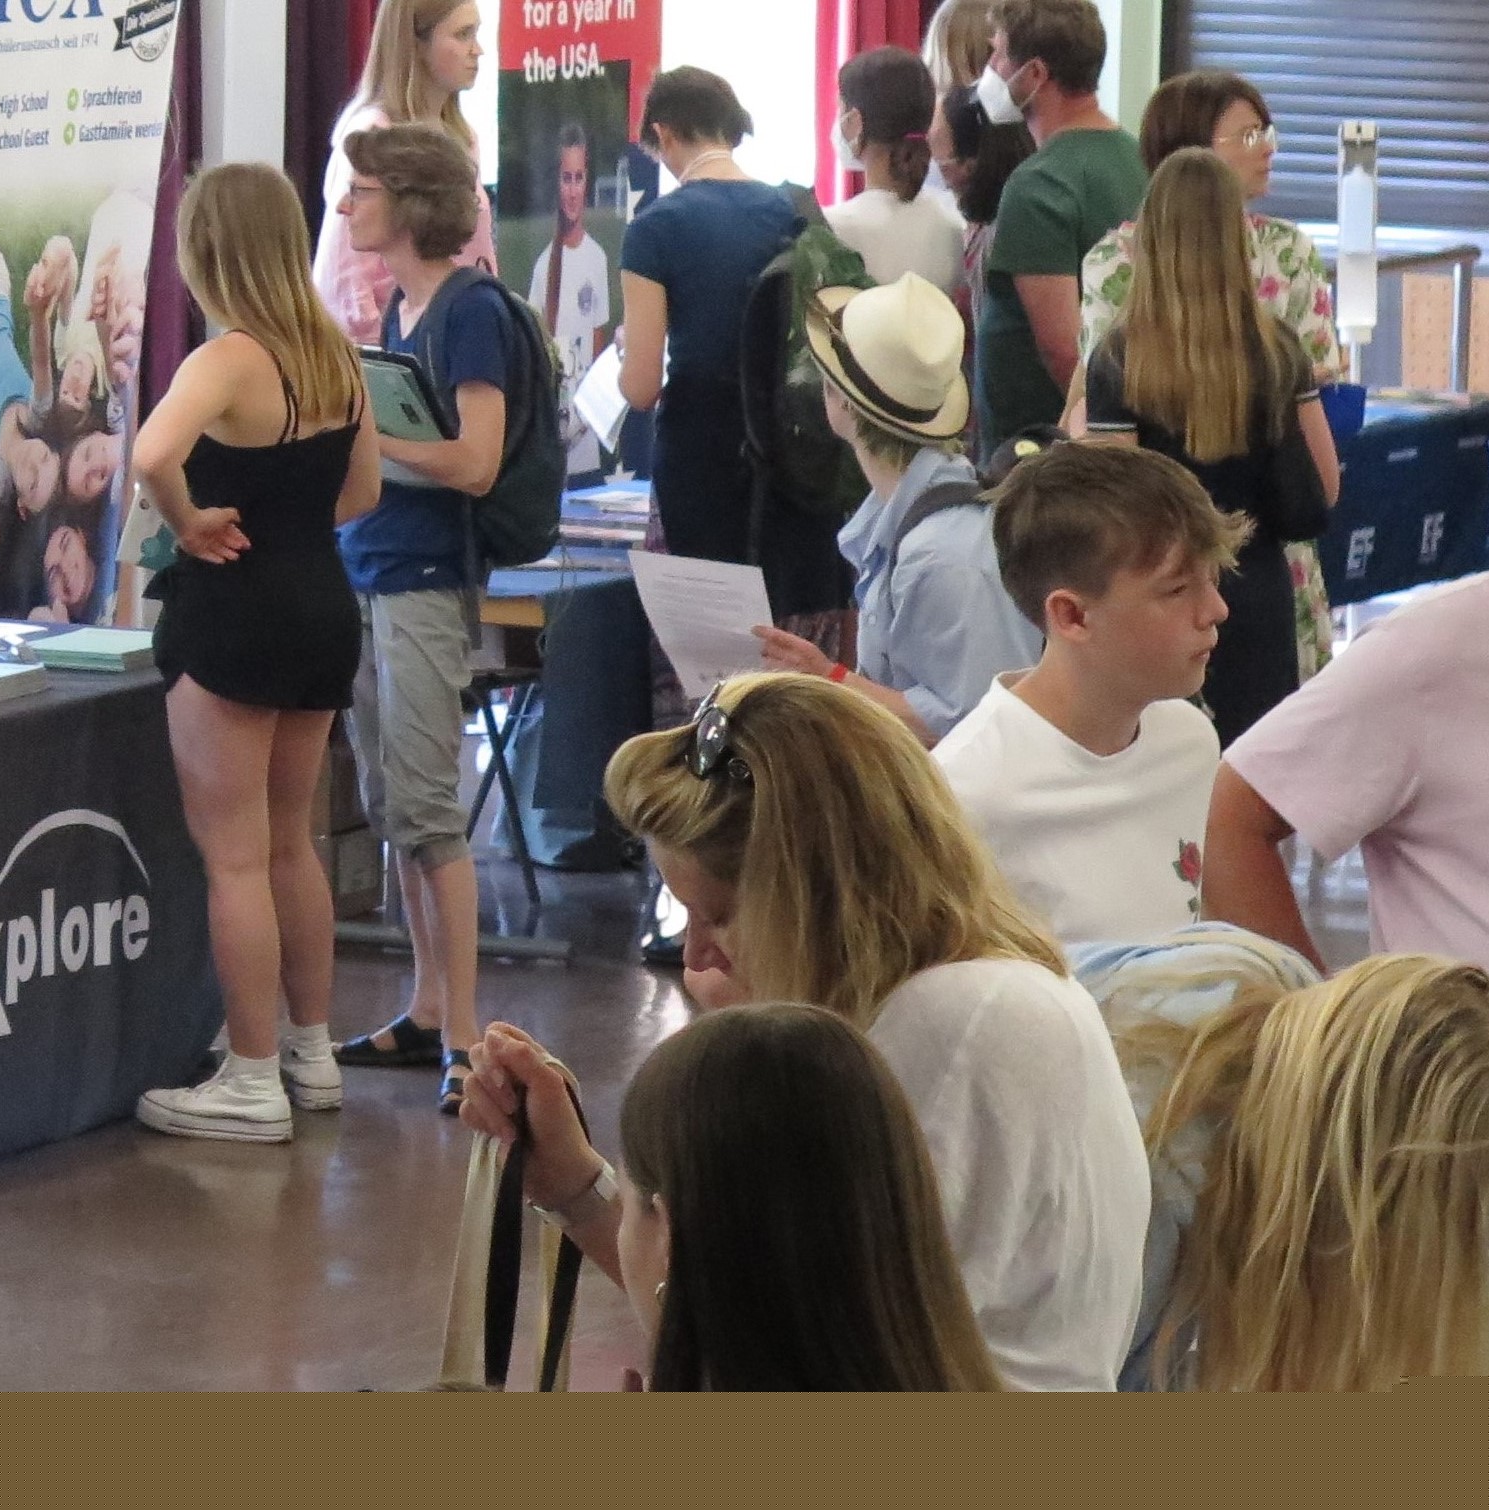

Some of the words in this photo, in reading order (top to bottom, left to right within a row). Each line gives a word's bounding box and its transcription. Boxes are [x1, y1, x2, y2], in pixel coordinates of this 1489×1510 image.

[523, 0, 554, 29] for
[557, 0, 568, 25] a
[573, 0, 612, 33] year
[617, 0, 636, 20] in
[63, 34, 78, 48] seit
[523, 46, 556, 83] the
[561, 42, 605, 80] USA.
[21, 90, 49, 112] School
[82, 86, 142, 111] Sprachferien
[24, 128, 50, 147] Guest
[79, 121, 133, 142] Gastfamilie
